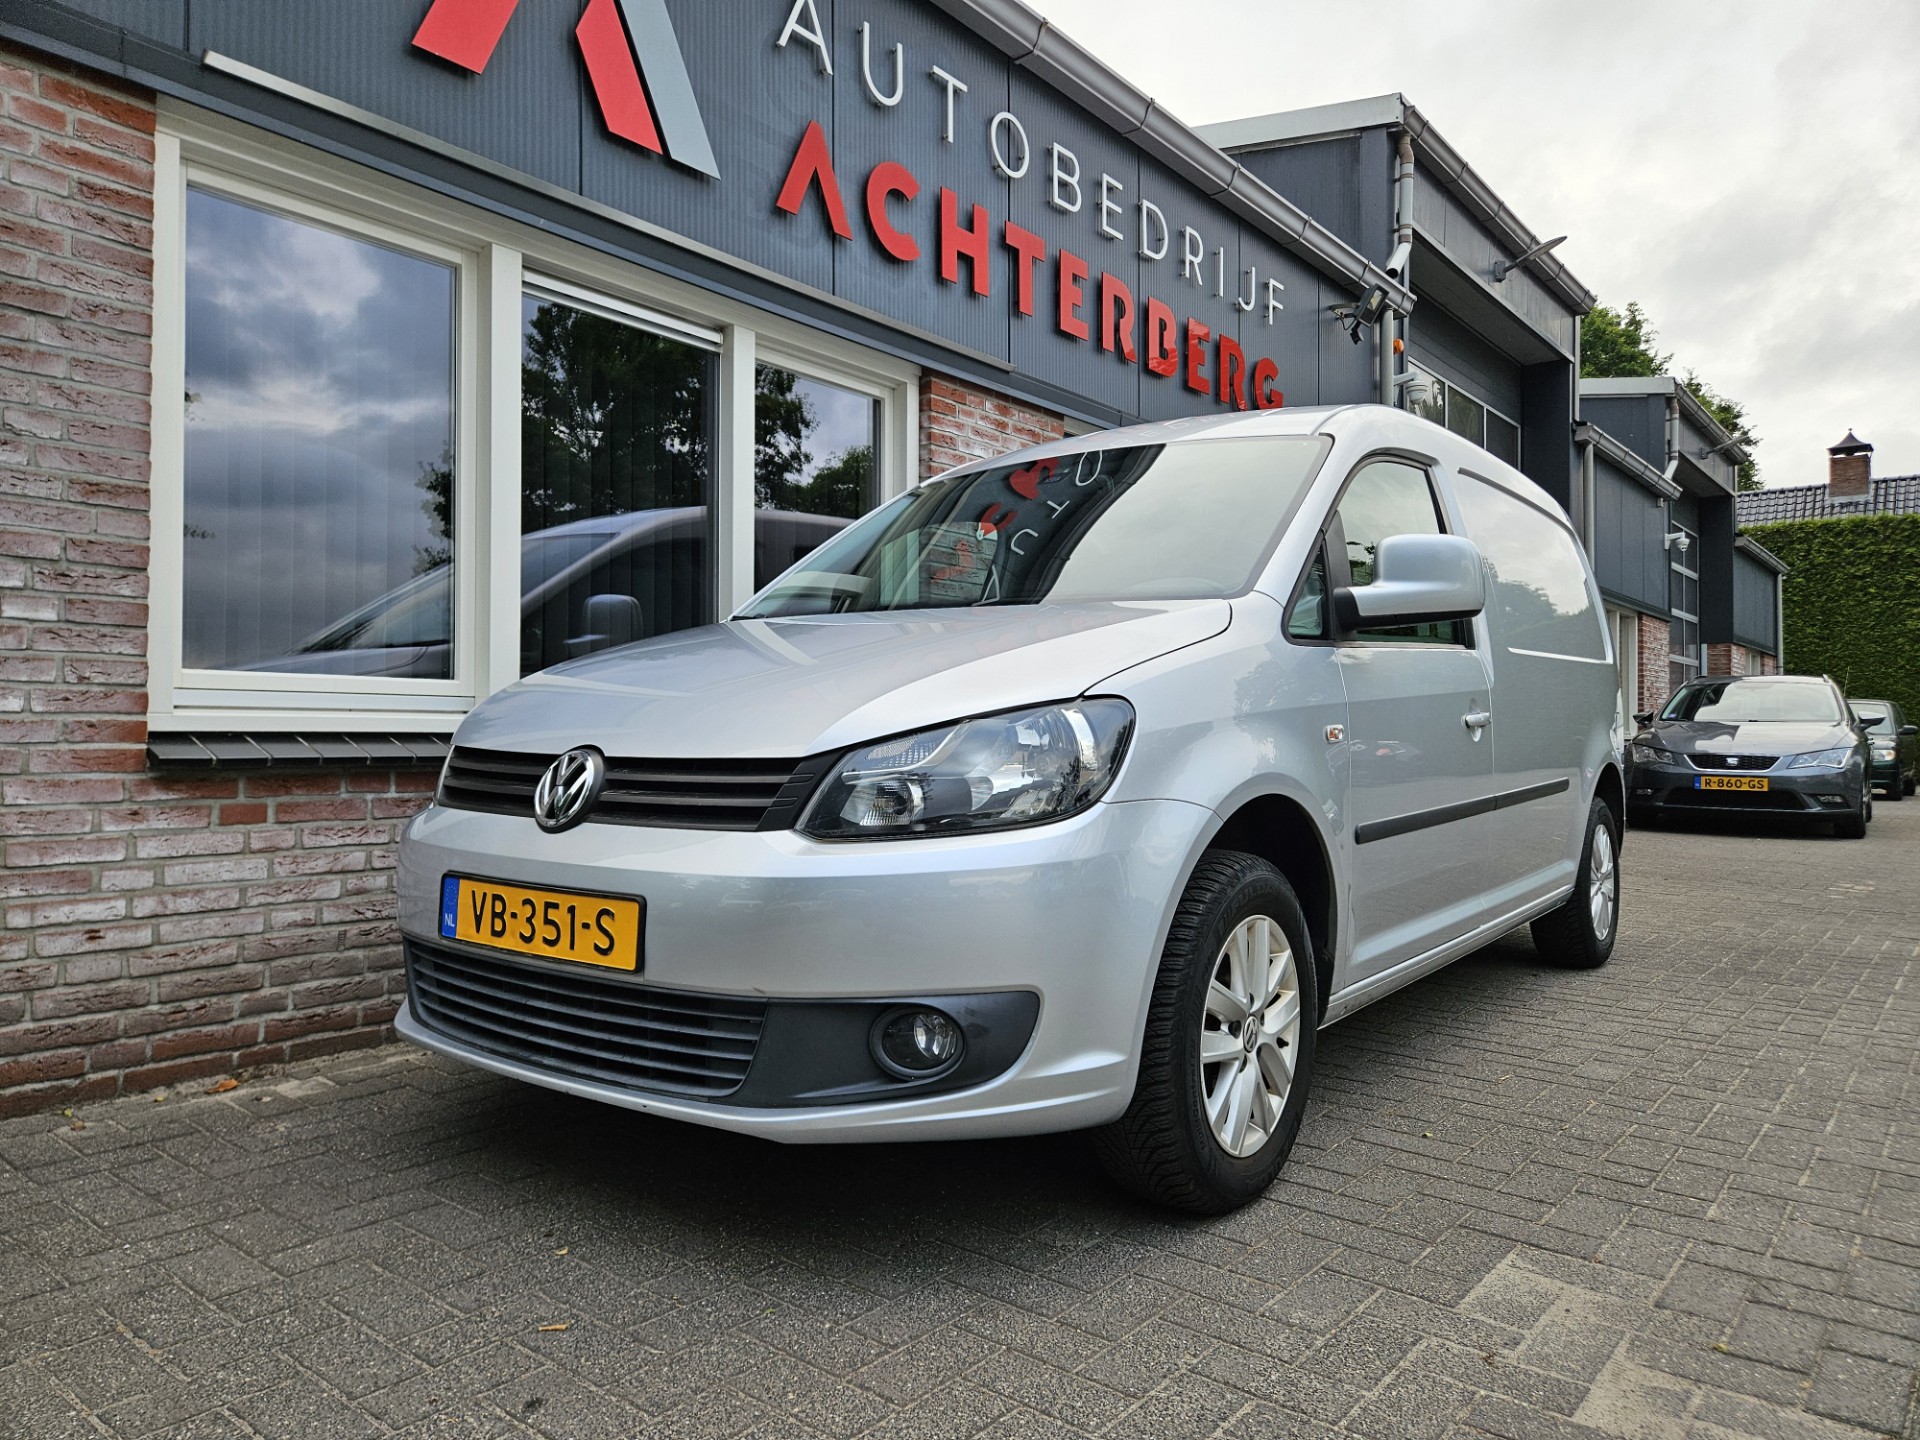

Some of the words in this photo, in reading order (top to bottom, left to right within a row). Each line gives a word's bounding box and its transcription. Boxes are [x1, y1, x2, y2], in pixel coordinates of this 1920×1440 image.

[777, 0, 1284, 325] AUTOBEDRIJF
[777, 120, 1284, 411] ACHTERBERG
[1704, 778, 1764, 789] R-860-GS
[471, 889, 615, 956] VB-351-S
